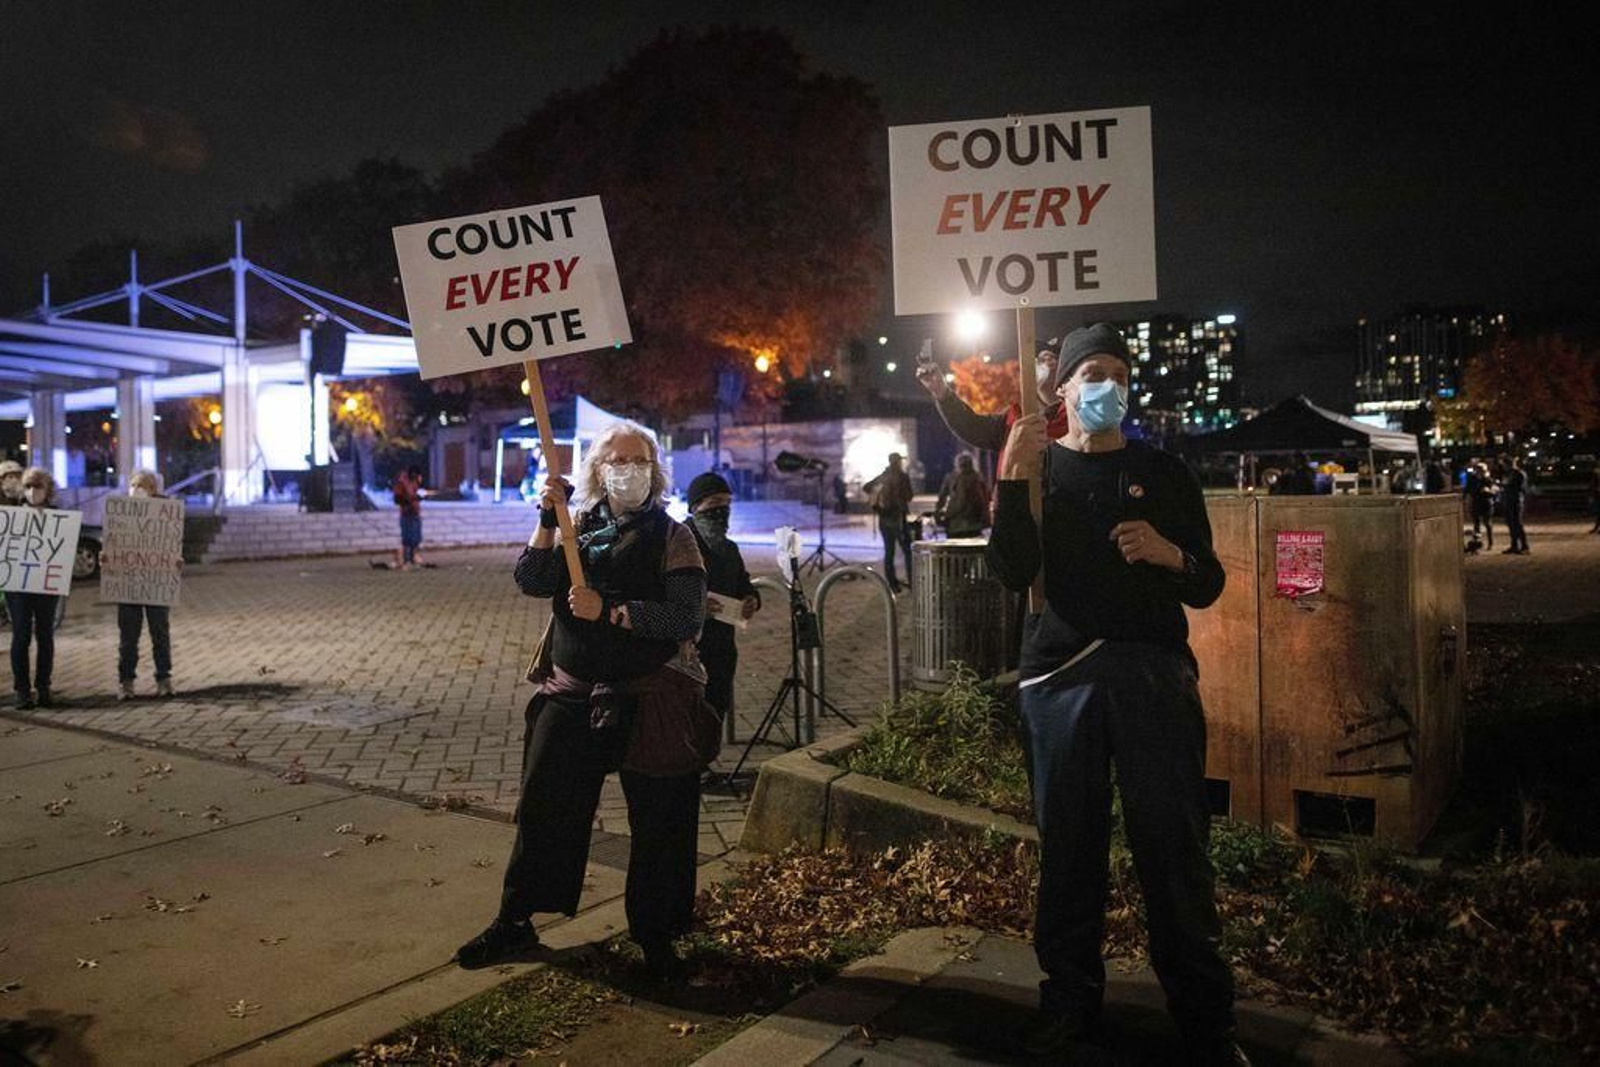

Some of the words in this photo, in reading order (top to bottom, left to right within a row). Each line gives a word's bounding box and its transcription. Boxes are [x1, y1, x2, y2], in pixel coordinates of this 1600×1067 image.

[928, 118, 1118, 172] COUNT
[427, 206, 577, 261] COUNT
[937, 183, 1111, 235] EVERY
[445, 256, 580, 311] EVERY
[957, 249, 1100, 297] VOTE
[466, 308, 587, 358] VOTE
[0, 510, 69, 538] OUNT
[0, 536, 64, 564] ERY
[113, 549, 170, 568] HONOR
[0, 561, 63, 591] OTE
